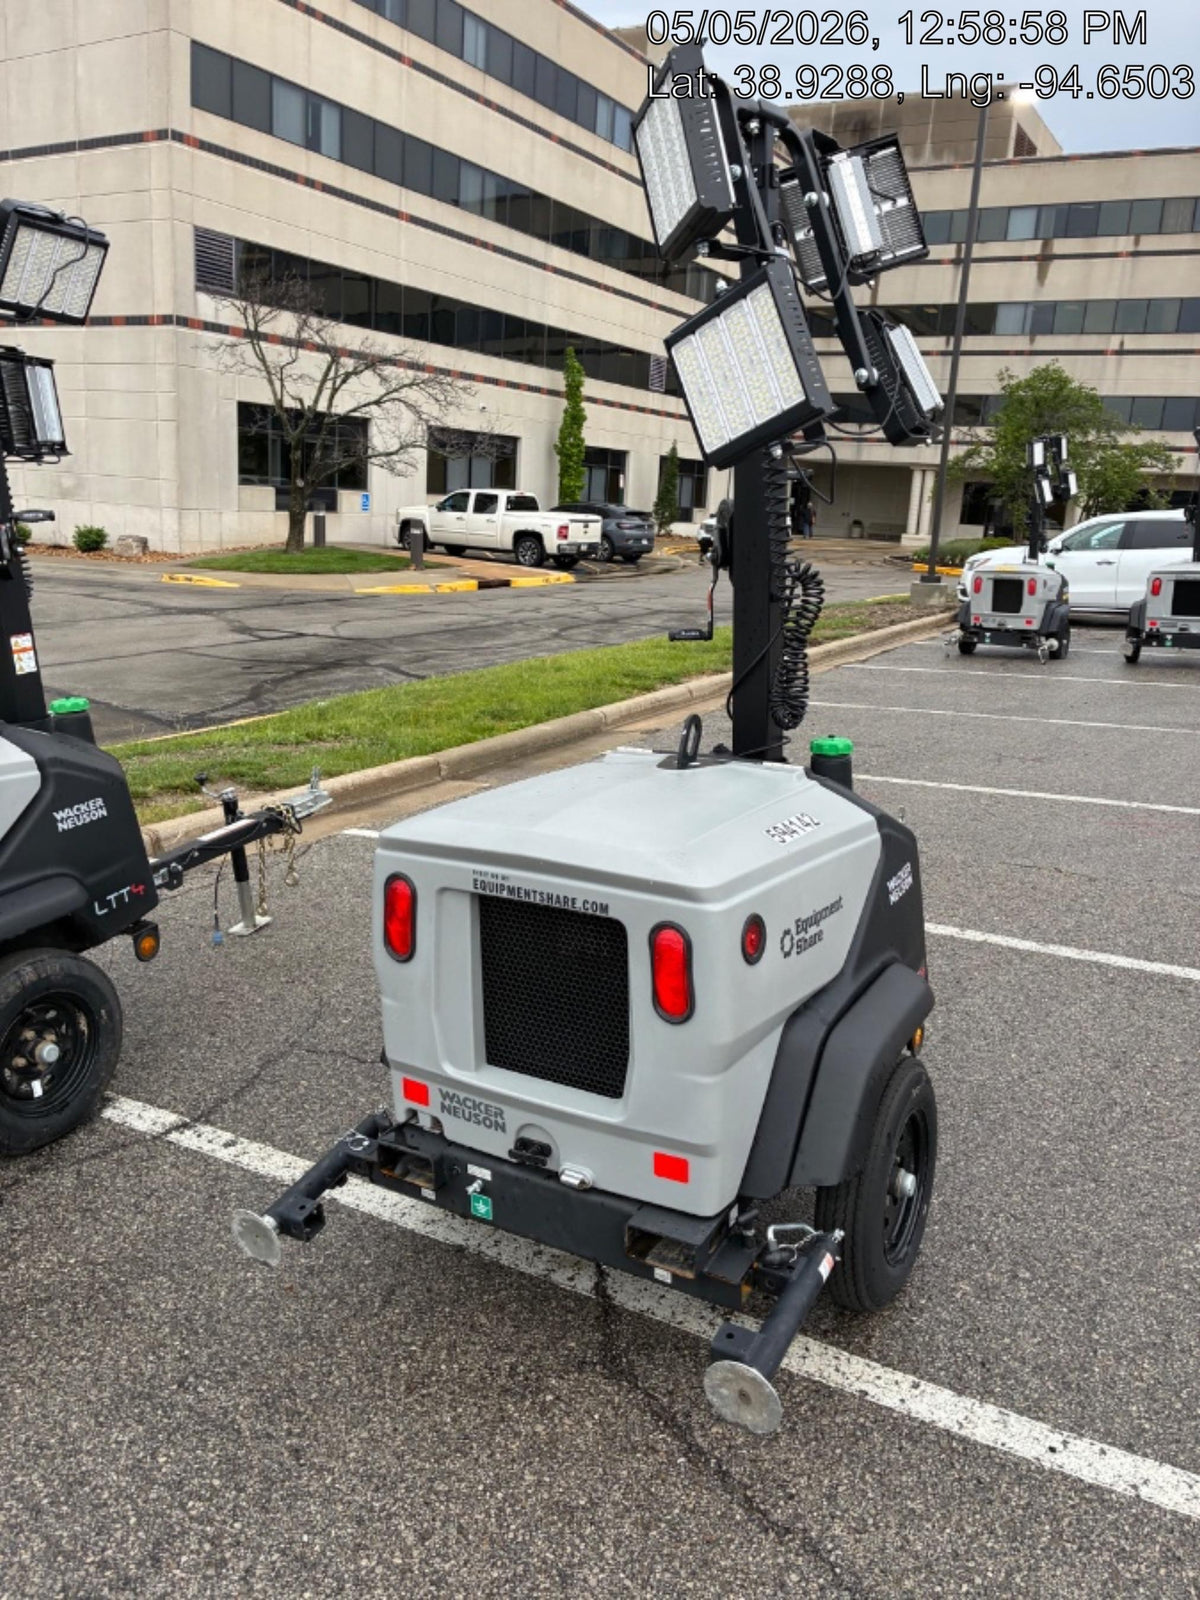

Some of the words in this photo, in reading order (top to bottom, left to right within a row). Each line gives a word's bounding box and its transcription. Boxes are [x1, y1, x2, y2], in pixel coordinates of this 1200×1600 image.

[53, 798, 105, 820] WACKER
[57, 807, 107, 832] NEUSON
[94, 883, 145, 916] LTT4
[473, 878, 609, 915] EQUIPMENTSHARE.COM
[795, 895, 843, 935] Equipment
[796, 929, 823, 955] Share
[438, 1087, 505, 1121] WACKER
[440, 1101, 506, 1133] NEUSON
